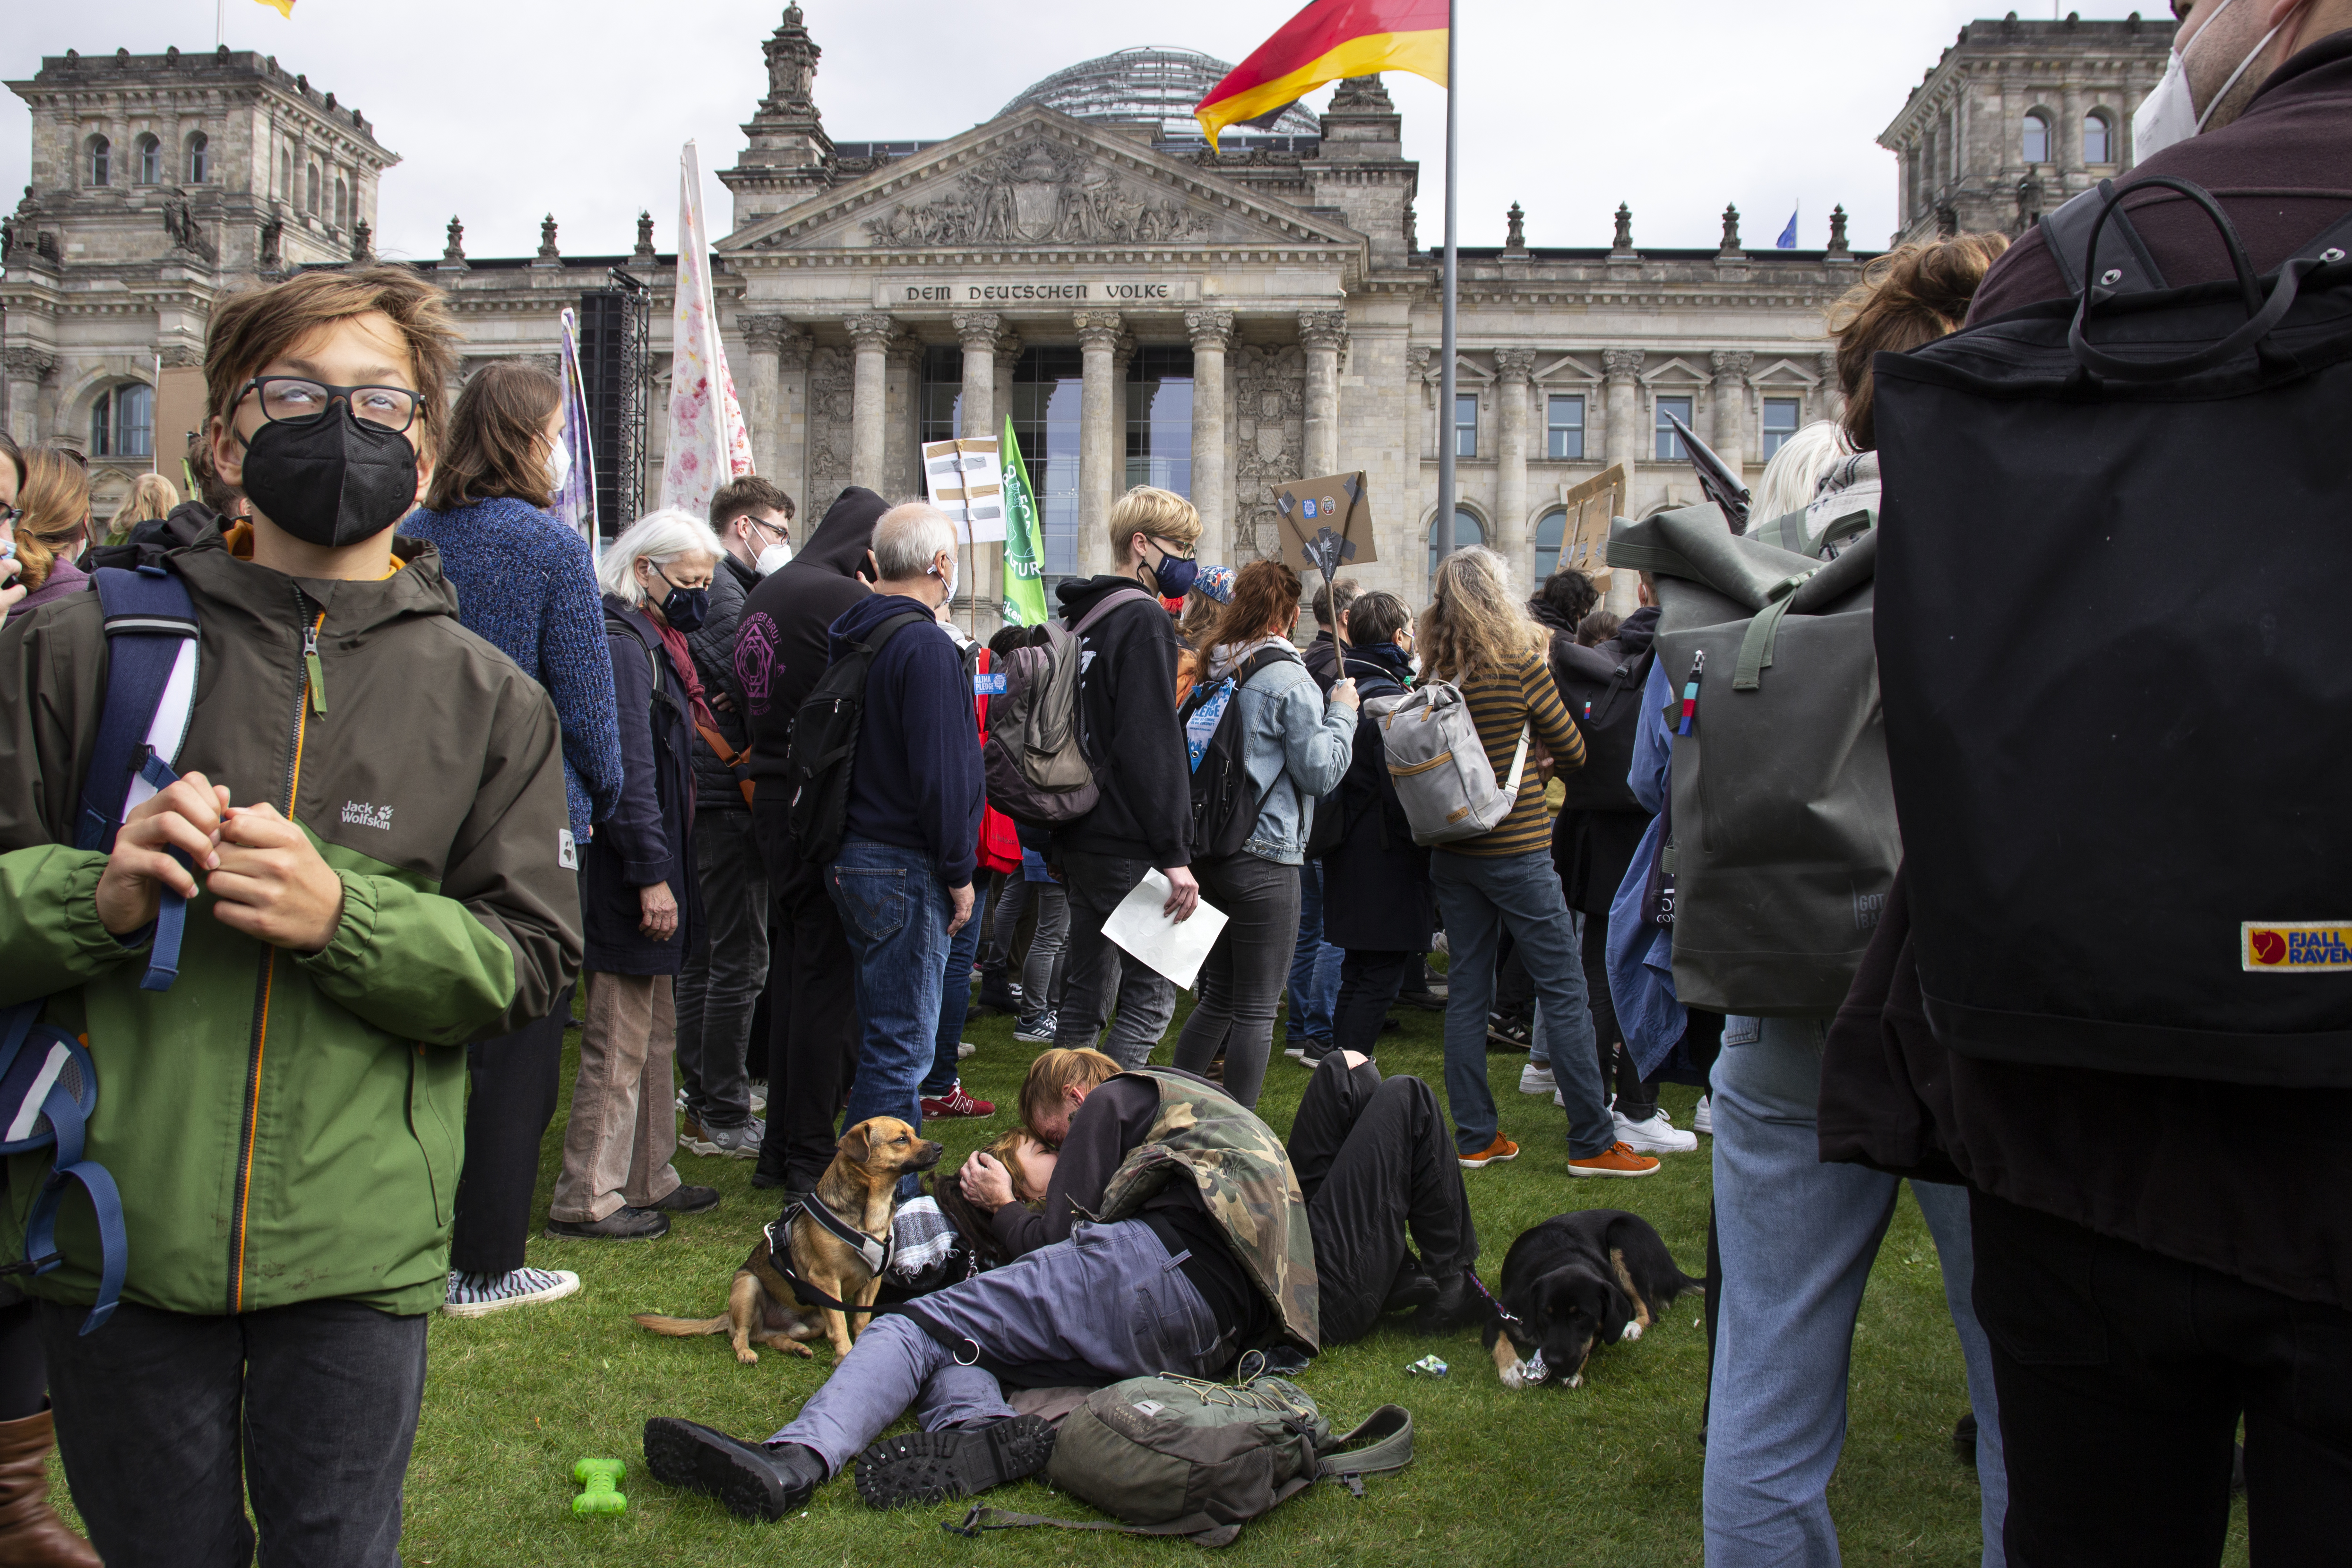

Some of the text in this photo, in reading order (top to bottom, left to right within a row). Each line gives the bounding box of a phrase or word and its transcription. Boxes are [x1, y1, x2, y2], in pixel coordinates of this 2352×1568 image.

[906, 284, 1168, 300] DEM DEUTSCHEN VOLKE
[1004, 546, 1040, 577] FUTUR
[734, 612, 782, 647] CARPENTER BRUT
[975, 675, 991, 683] KLIMA
[975, 682, 994, 690] PLEDGE
[342, 800, 374, 814] Jack
[1450, 810, 1465, 820] MELA
[342, 811, 390, 830] Wolfskin
[1859, 893, 1884, 911] GOT
[1861, 913, 1883, 929] BA
[1114, 1413, 1144, 1434] CLASSIC
[1116, 1406, 1150, 1430] BOREALIS
